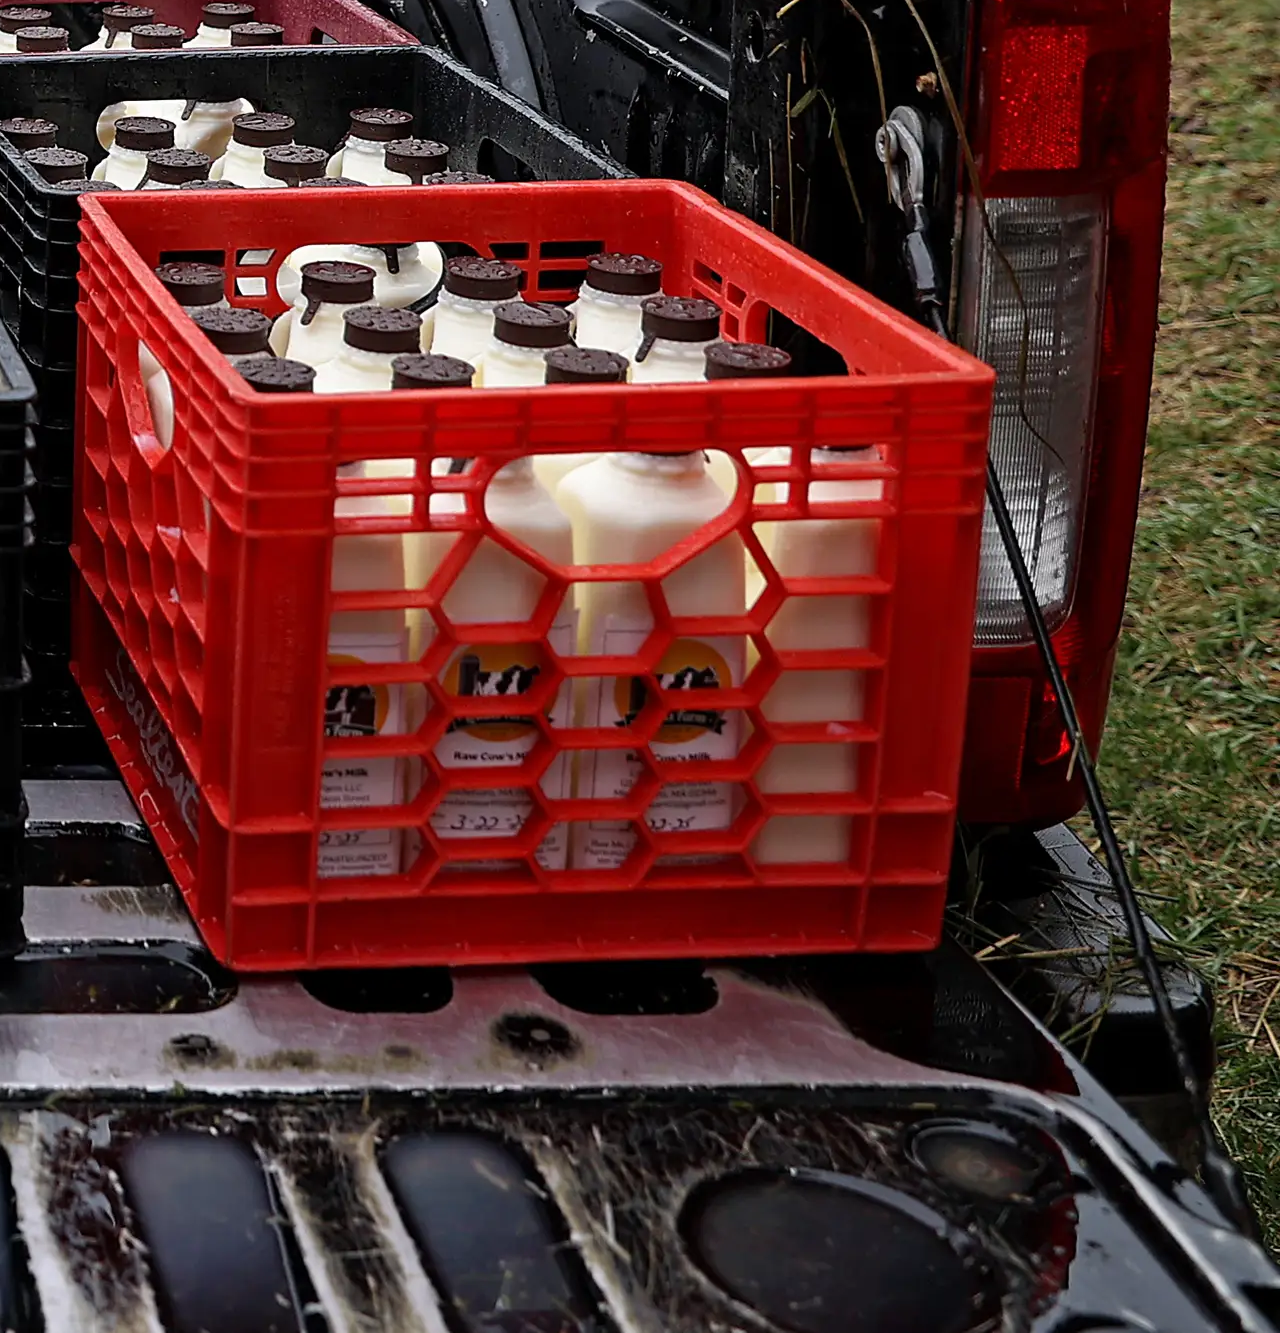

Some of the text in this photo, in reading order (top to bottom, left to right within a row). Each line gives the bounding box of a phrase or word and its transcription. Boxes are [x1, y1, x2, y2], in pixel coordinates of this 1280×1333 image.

[677, 712, 707, 723] Farm
[105, 647, 200, 846] Sealtest
[453, 751, 477, 761] Raw
[480, 751, 514, 761] Cow's
[688, 751, 711, 761] Milk
[345, 767, 369, 777] Milk
[450, 813, 526, 831] 3-22-2
